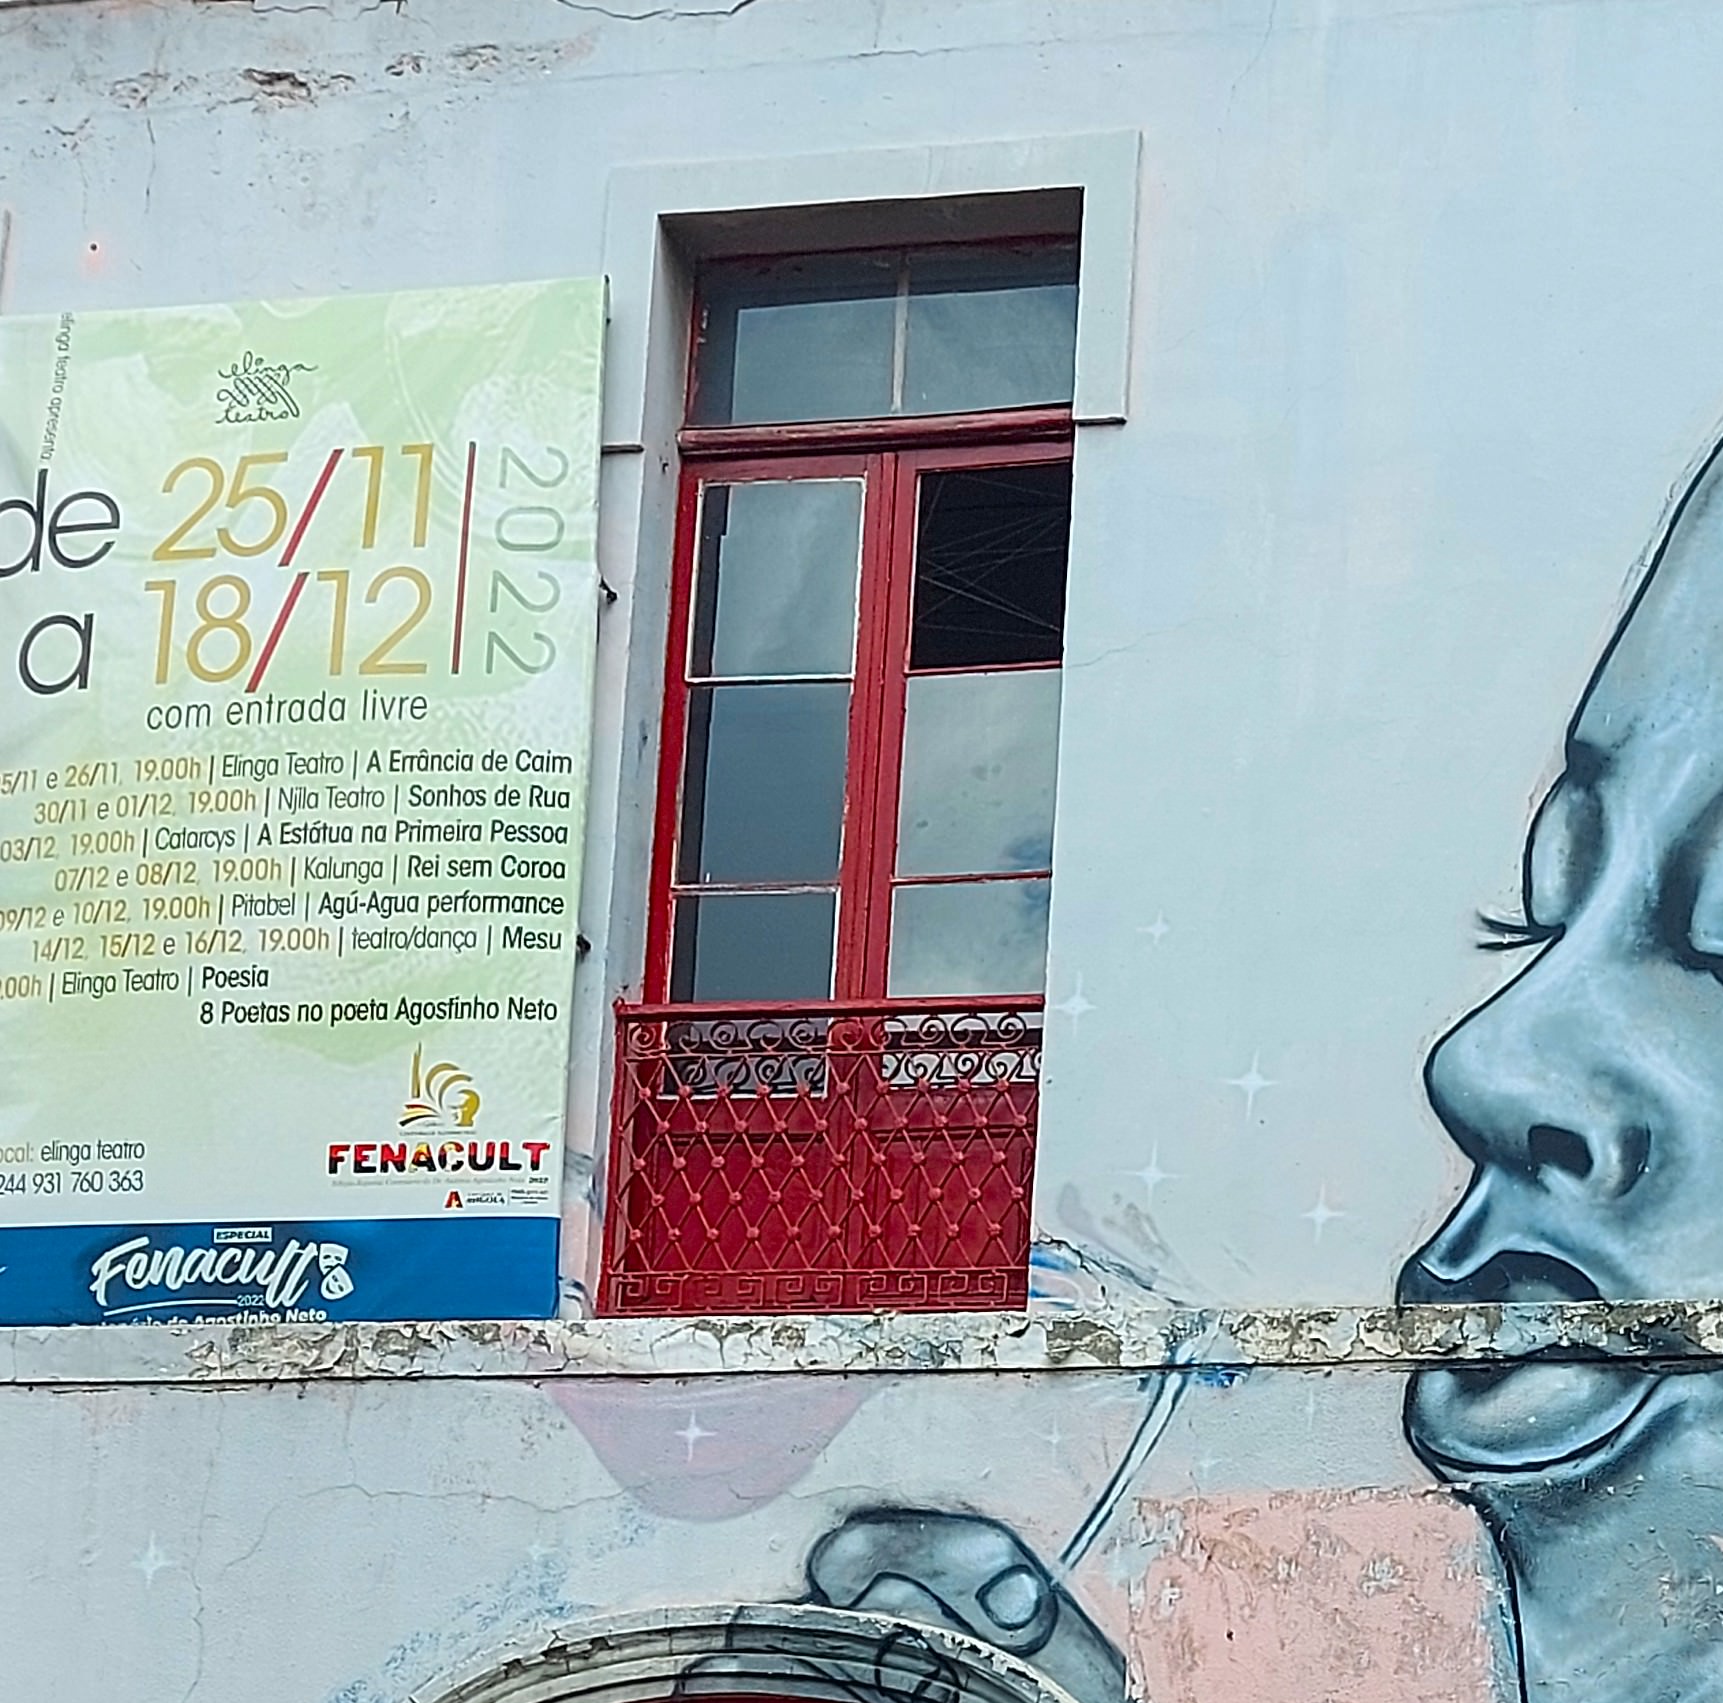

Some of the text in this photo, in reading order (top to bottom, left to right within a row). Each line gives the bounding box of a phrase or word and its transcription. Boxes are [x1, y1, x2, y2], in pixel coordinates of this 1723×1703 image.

[52, 355, 71, 393] teatro
[0, 443, 435, 578] de 25/11
[485, 445, 569, 677] 2022
[18, 566, 432, 695] a 18/12
[146, 690, 429, 730] com entrada livre
[0, 769, 37, 795] 5/11
[46, 771, 58, 790] e
[135, 757, 201, 781] 19.00h
[222, 755, 278, 781] Elinga
[286, 751, 344, 775] Teatro
[366, 750, 381, 774] A
[389, 749, 473, 774] Errância
[481, 750, 508, 772] de
[515, 749, 573, 775] Caim
[34, 798, 87, 824] 30/11
[97, 802, 109, 820] e
[189, 788, 257, 814] 19.00h
[326, 786, 386, 809] Teatro
[408, 784, 487, 808] Sonhos
[494, 784, 521, 807] de
[529, 785, 571, 809] Rua
[70, 830, 135, 856] 19.00h
[155, 826, 237, 853] Catarcys
[257, 822, 273, 846] A
[279, 820, 354, 844] Estátua
[361, 824, 388, 844] na
[395, 819, 483, 844] Primeira
[490, 819, 569, 844] Pessoa
[55, 866, 109, 892] 07/12
[116, 868, 129, 888] e
[213, 857, 282, 883] 19.00h
[304, 855, 384, 884] Kalunga
[408, 854, 440, 879] Rei
[446, 857, 493, 879] sem
[500, 854, 567, 879] Coroa
[53, 908, 65, 927] e
[143, 896, 210, 921] 19.00h
[232, 892, 295, 918] Pitabel
[318, 889, 419, 920] Agú-Agua
[427, 889, 565, 918] performance
[100, 932, 155, 960] 15/12
[163, 937, 176, 956] e
[258, 926, 330, 953] 19.00h
[352, 925, 477, 954] teatro/dança
[502, 926, 562, 950] Mesu
[62, 971, 117, 999] Elinga
[122, 968, 180, 993] Teatro
[202, 964, 269, 989] Poesia
[200, 994, 558, 1028] 8 Poetas no poeta Agostinho Neto
[41, 1139, 91, 1167] elinga
[97, 1138, 145, 1160] teatro
[328, 1142, 551, 1174] FENACULT
[32, 1172, 61, 1194] 931
[70, 1170, 104, 1193] 760
[108, 1170, 144, 1193] 363
[216, 1230, 270, 1241] ESPECIAL
[236, 1295, 265, 1308] 2022
